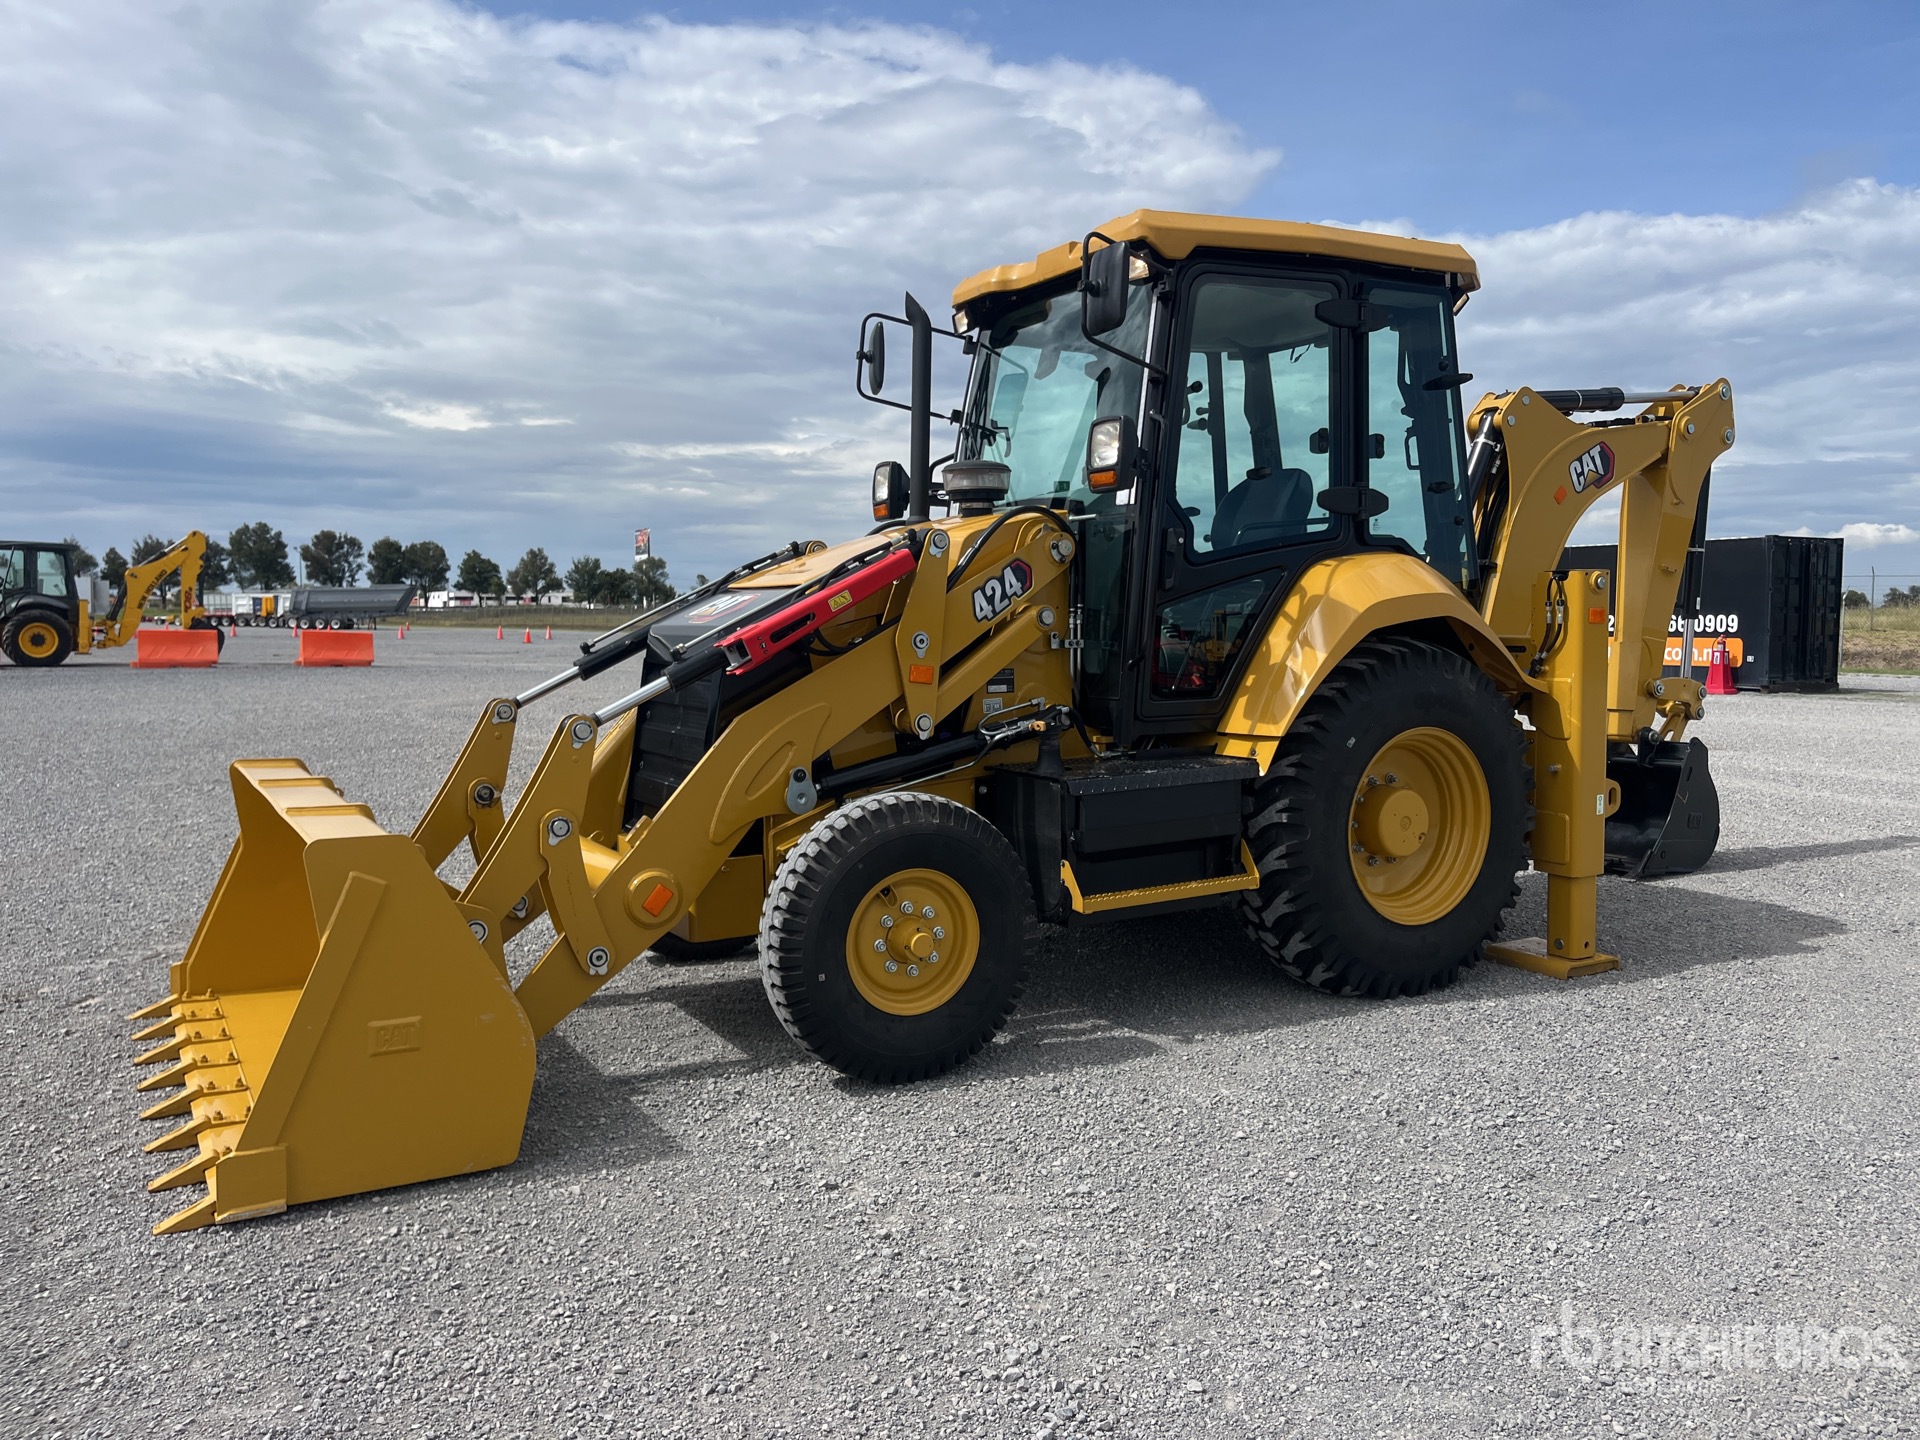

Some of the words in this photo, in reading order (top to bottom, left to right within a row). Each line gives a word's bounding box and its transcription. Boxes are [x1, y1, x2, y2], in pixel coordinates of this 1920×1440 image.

[1570, 444, 1604, 492] CAT
[145, 569, 168, 594] HOLLAND
[973, 567, 1023, 621] 424
